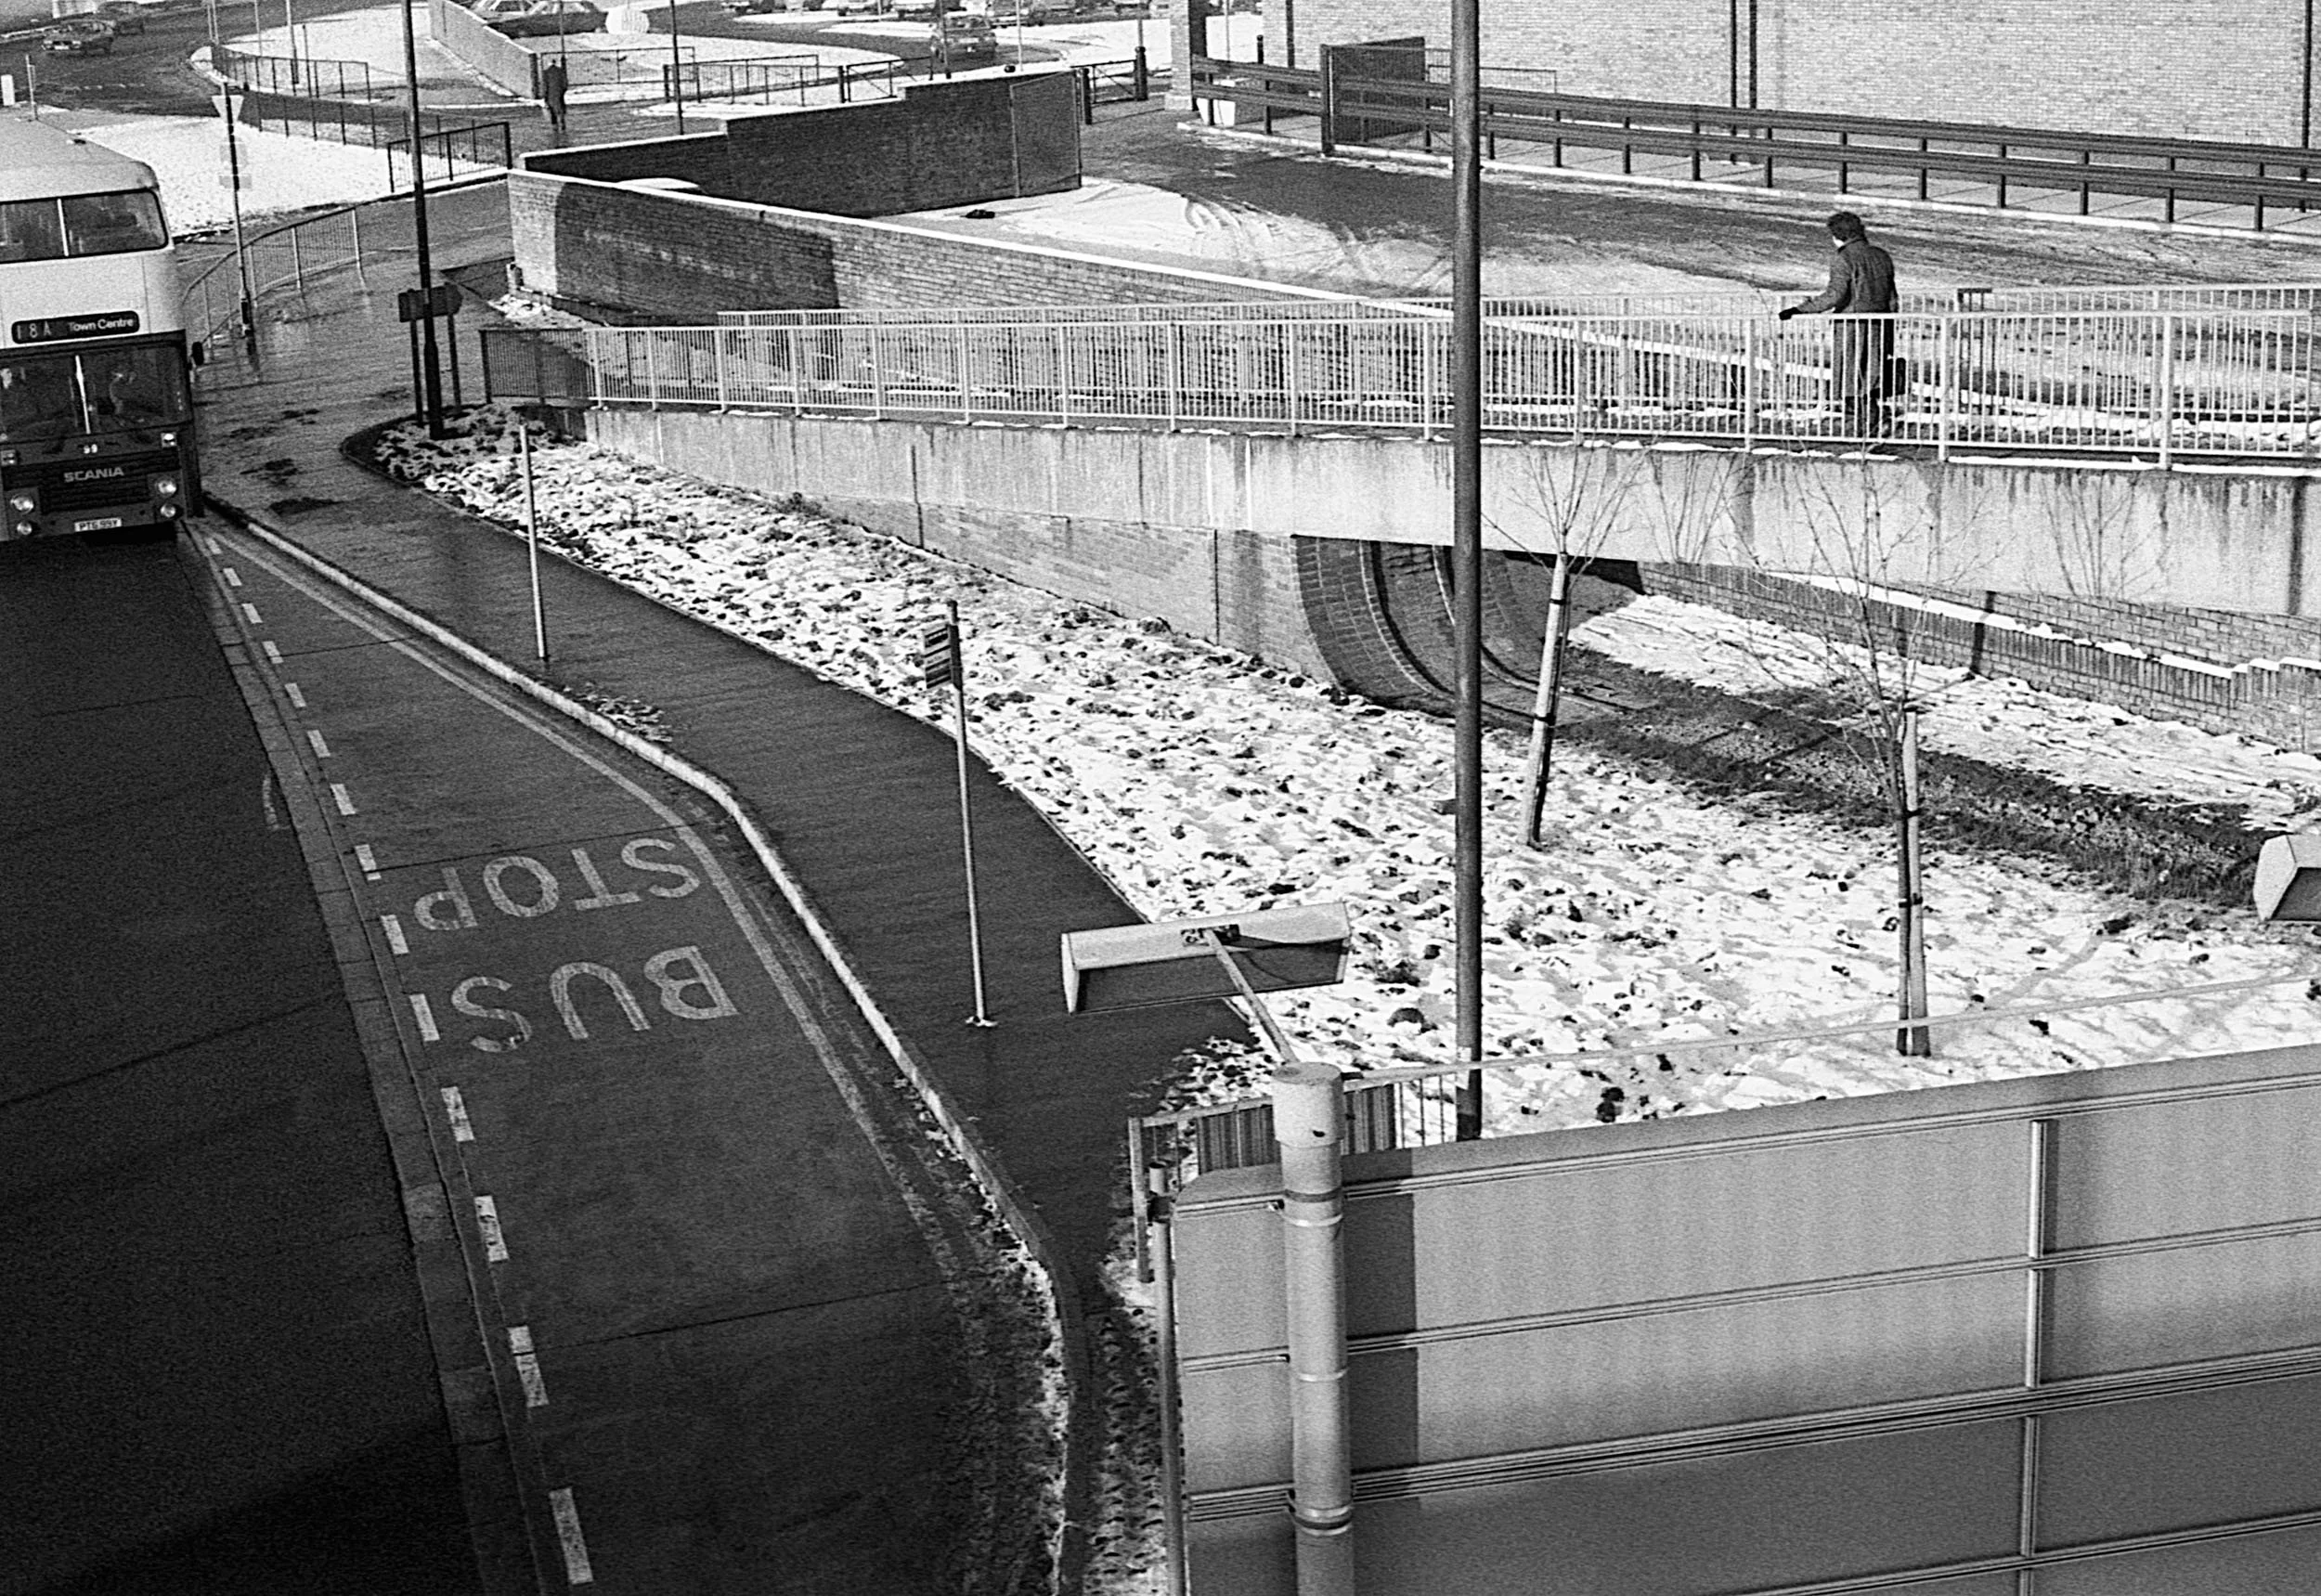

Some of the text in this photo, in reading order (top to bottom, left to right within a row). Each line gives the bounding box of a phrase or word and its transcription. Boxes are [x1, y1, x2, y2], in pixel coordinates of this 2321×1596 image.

[67, 321, 97, 332] Town
[97, 318, 134, 330] Centre
[64, 466, 124, 483] SCANIA
[414, 838, 700, 930] STOP
[451, 946, 740, 1052] BUS
